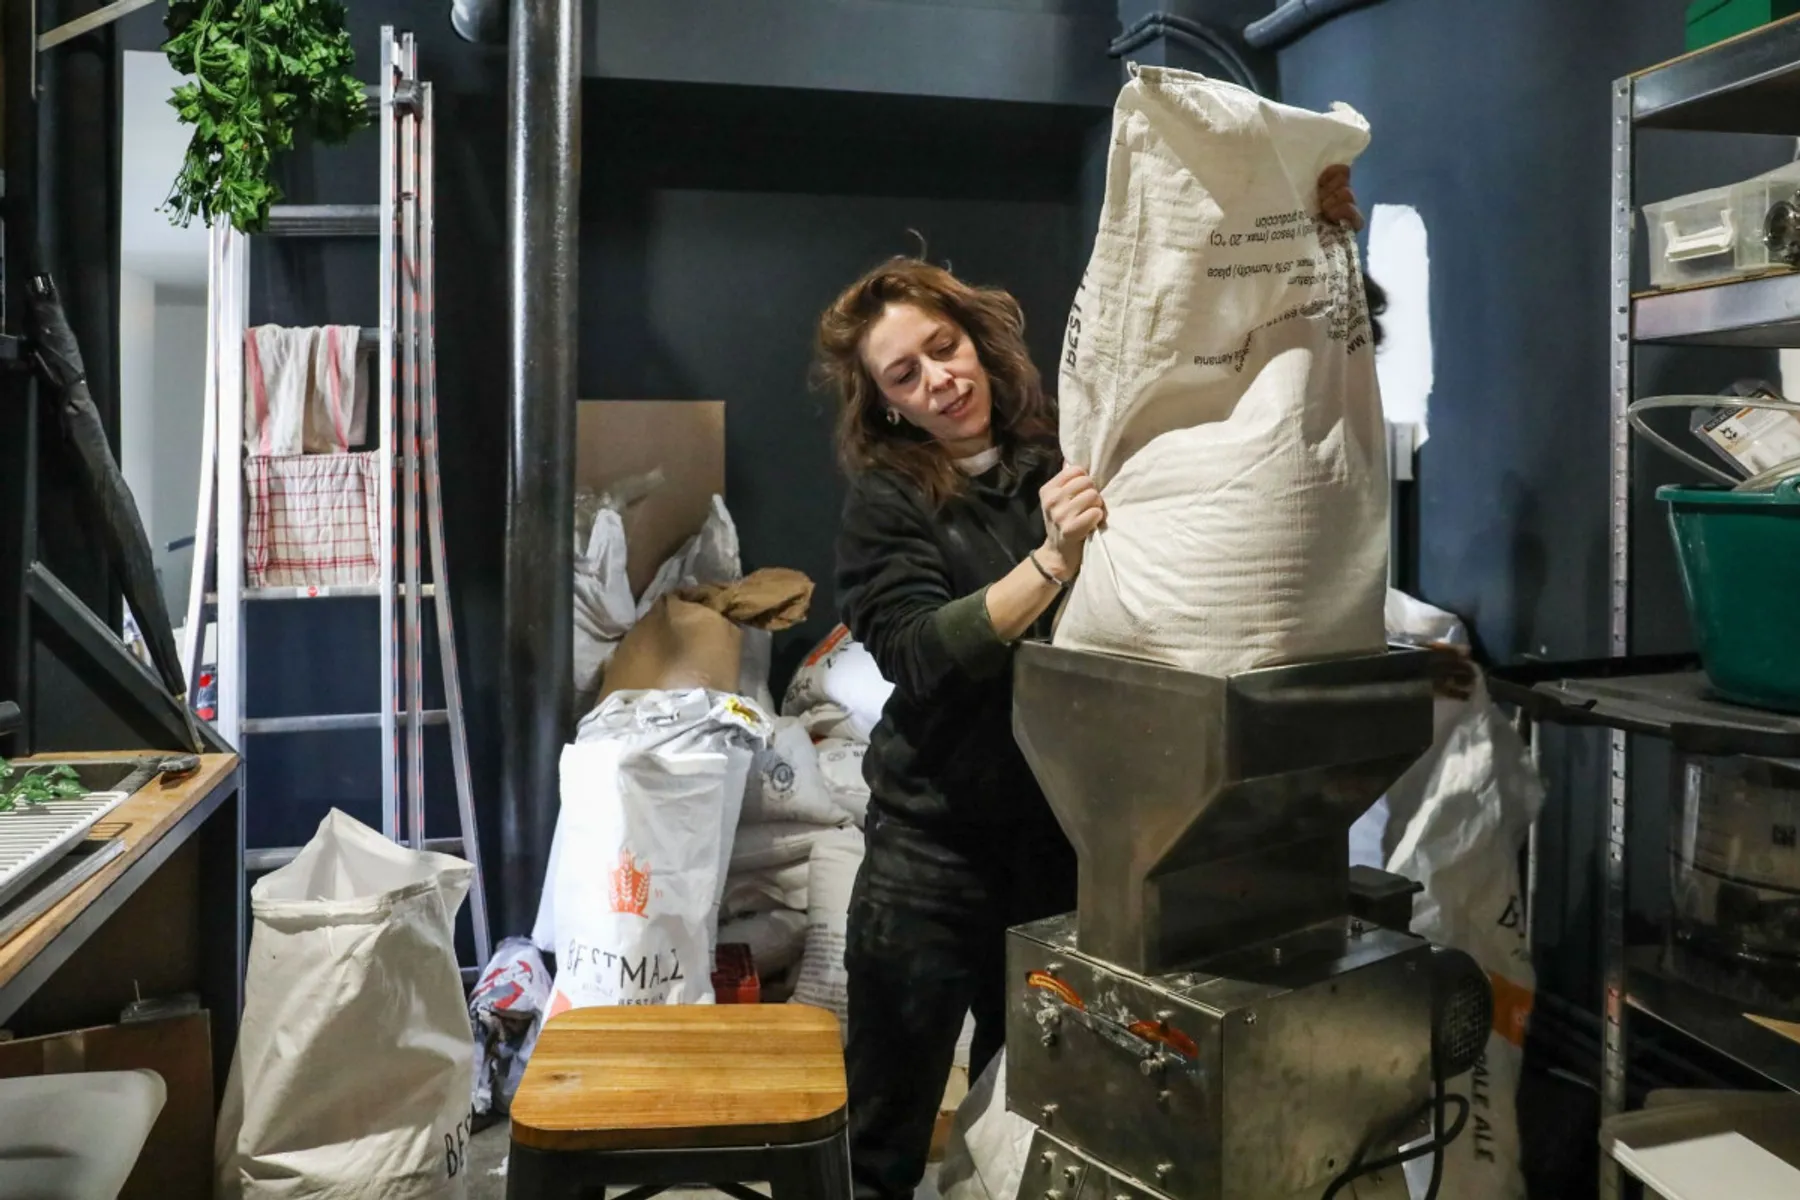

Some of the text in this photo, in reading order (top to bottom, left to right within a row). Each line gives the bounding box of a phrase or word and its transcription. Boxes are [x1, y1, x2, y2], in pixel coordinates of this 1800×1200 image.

[1229, 233, 1243, 247] 20
[1207, 264, 1232, 280] place
[1473, 1114, 1496, 1164] ALE
